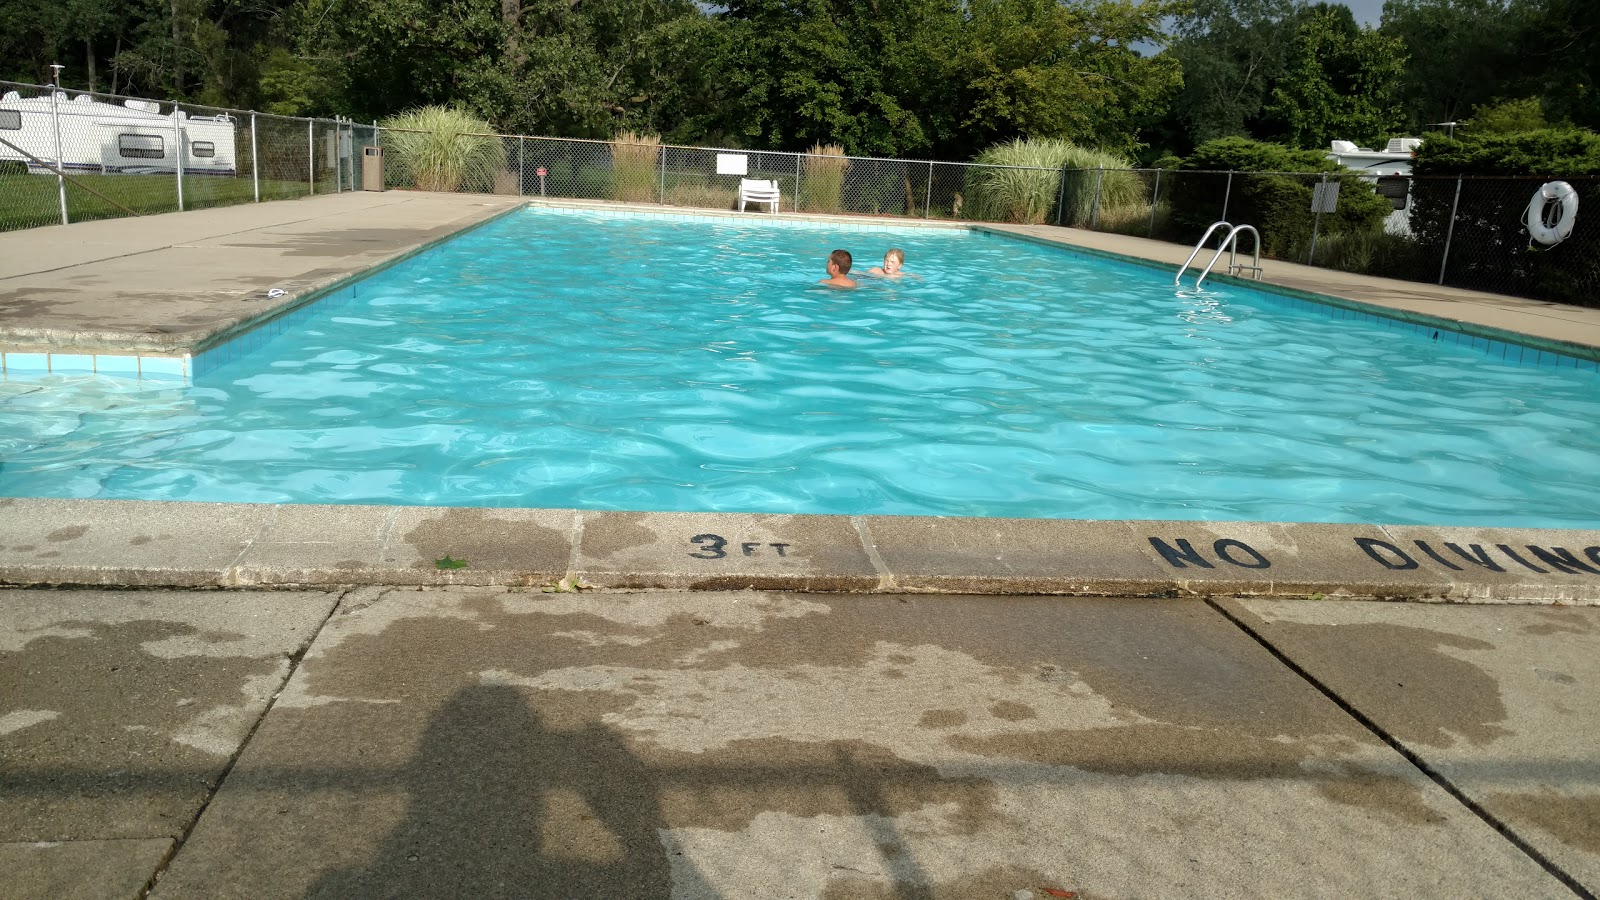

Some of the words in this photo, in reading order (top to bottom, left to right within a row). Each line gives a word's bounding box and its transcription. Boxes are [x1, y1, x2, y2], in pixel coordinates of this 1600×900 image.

[687, 533, 728, 559] 3
[741, 542, 791, 557] FT
[1148, 536, 1271, 569] NO
